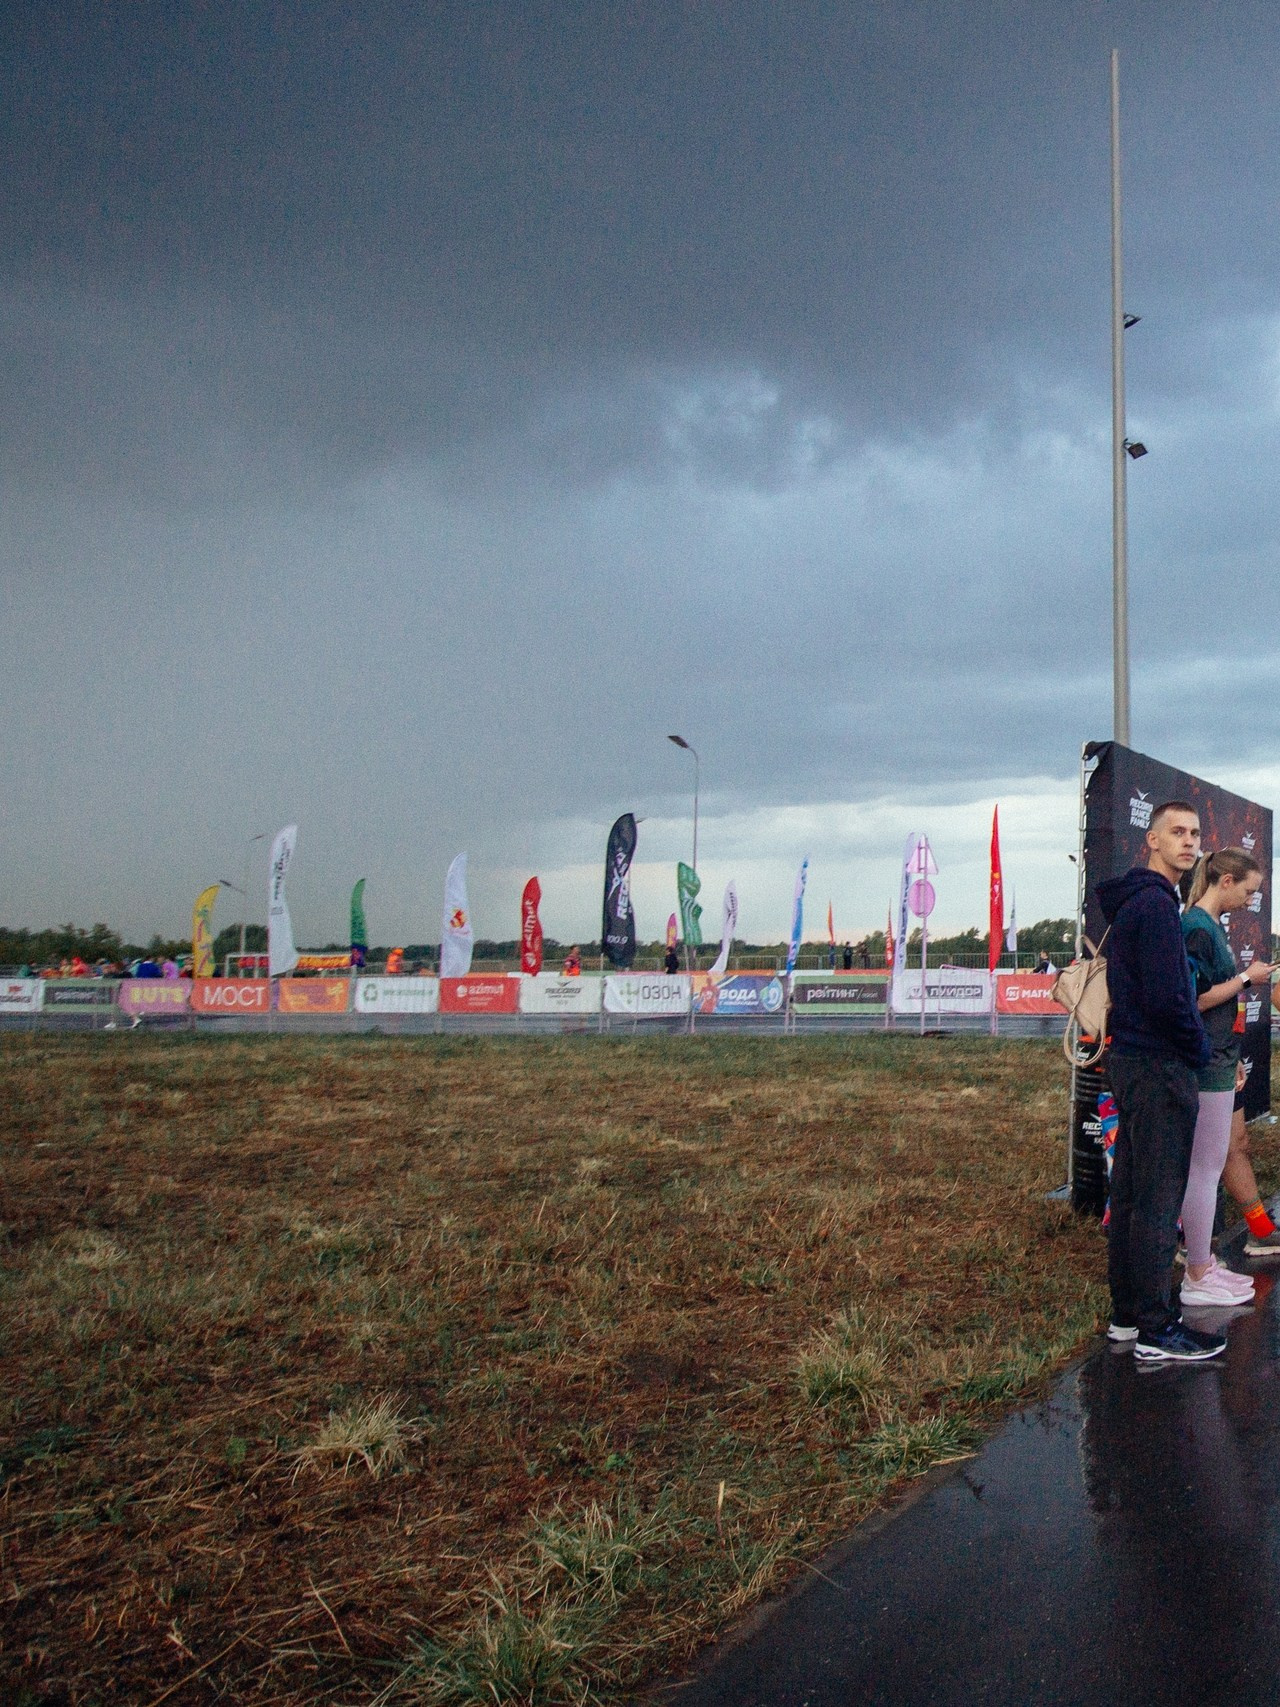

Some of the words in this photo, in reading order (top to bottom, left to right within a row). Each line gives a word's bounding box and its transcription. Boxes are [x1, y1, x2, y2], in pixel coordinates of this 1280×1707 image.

[204, 986, 265, 1006] МОСТ
[718, 988, 757, 1001] ВОДА
[1021, 989, 1051, 999] МАГН
[1082, 1121, 1103, 1130] REC
